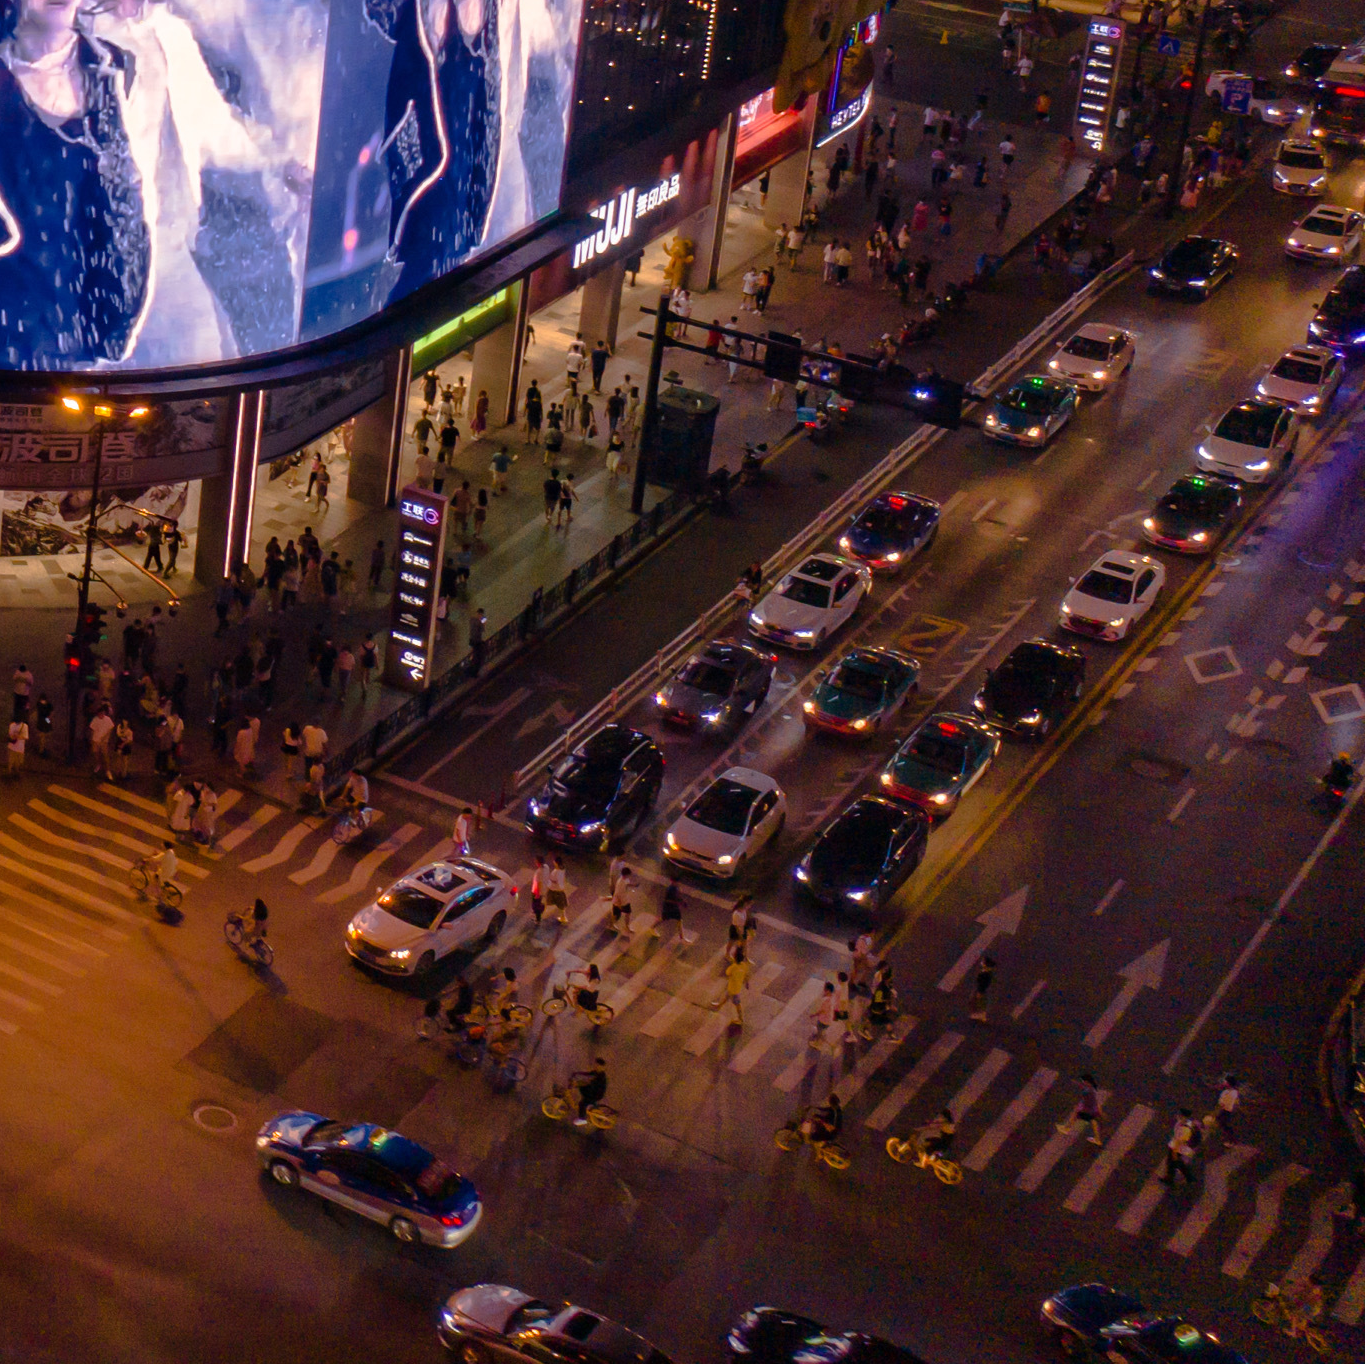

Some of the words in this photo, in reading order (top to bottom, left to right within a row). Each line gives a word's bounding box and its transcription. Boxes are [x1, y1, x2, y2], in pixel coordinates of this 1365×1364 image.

[634, 172, 681, 219] 無印良品
[0, 432, 137, 463] 波司登
